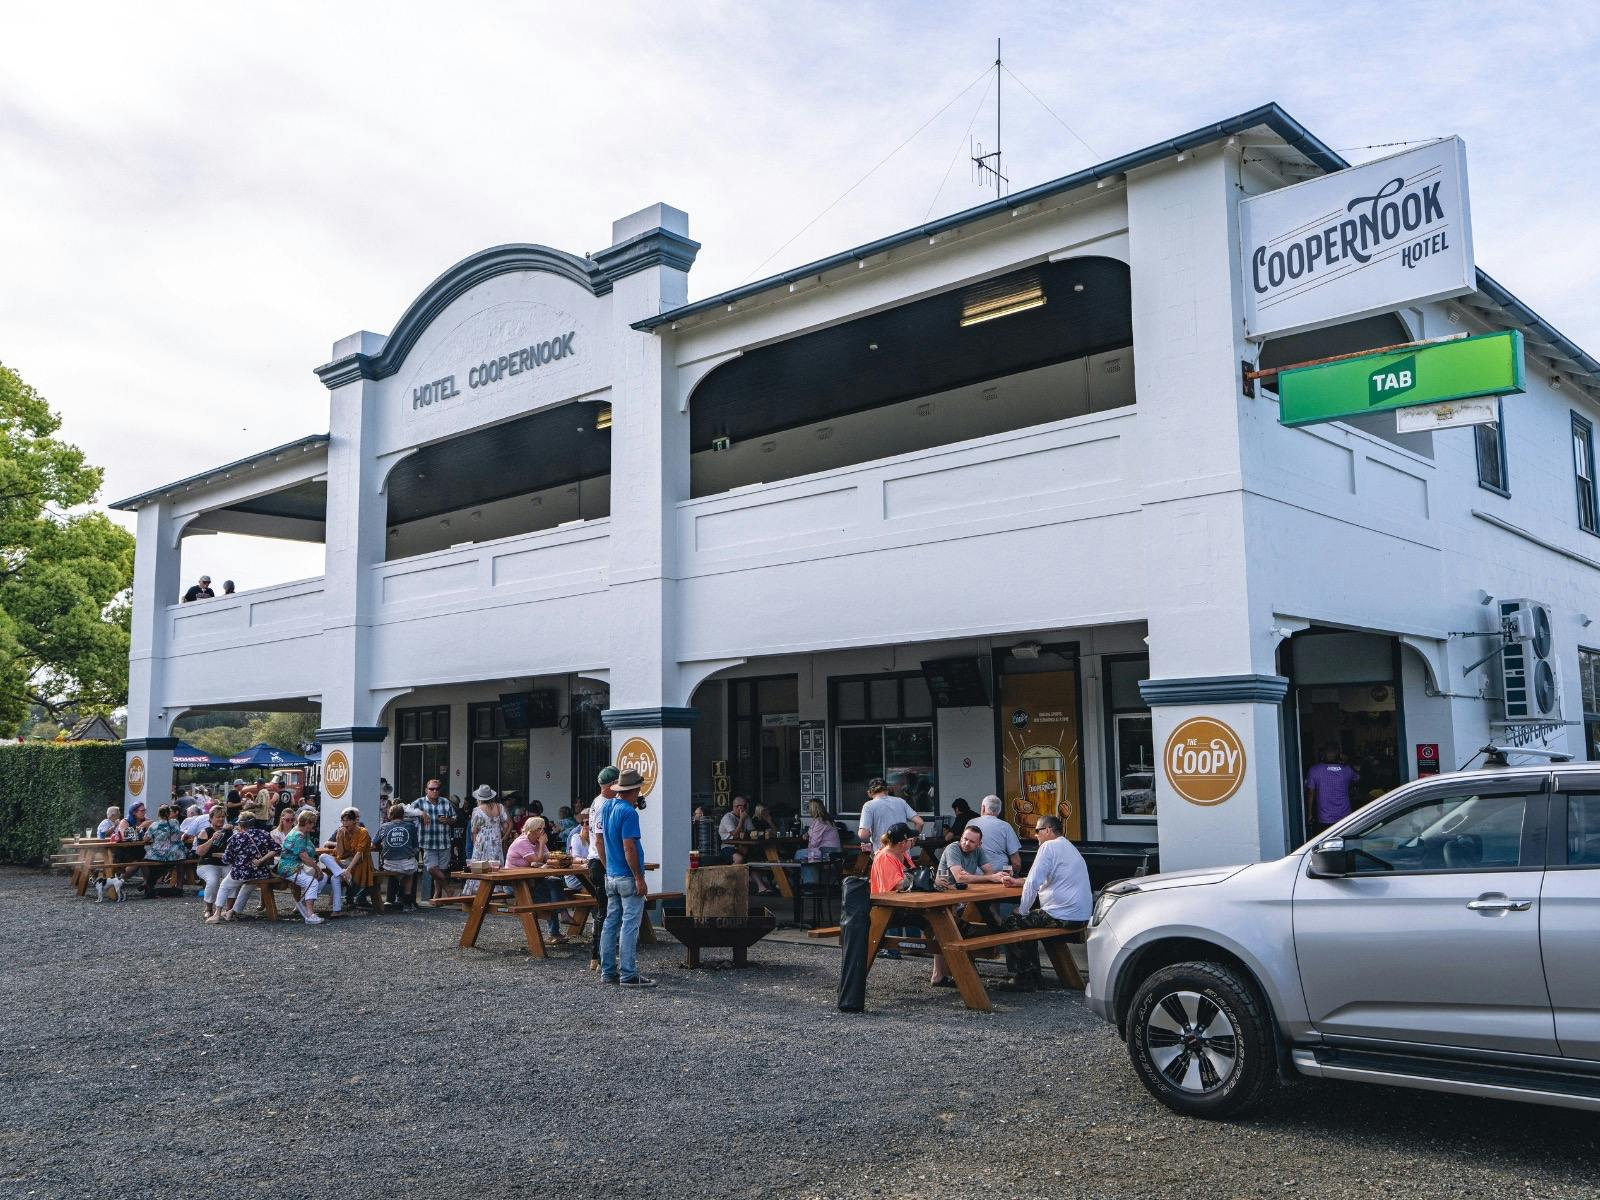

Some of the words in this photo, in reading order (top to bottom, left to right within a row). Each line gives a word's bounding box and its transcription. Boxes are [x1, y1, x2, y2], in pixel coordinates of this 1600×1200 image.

[1253, 177, 1444, 293] COOPERNOOK
[1401, 231, 1449, 269] HOTEL
[412, 374, 460, 410] HOTEL
[469, 331, 575, 389] COOPERNOOK
[1372, 370, 1412, 391] TAB
[1172, 738, 1239, 774] COOPY
[1186, 738, 1198, 746] THE
